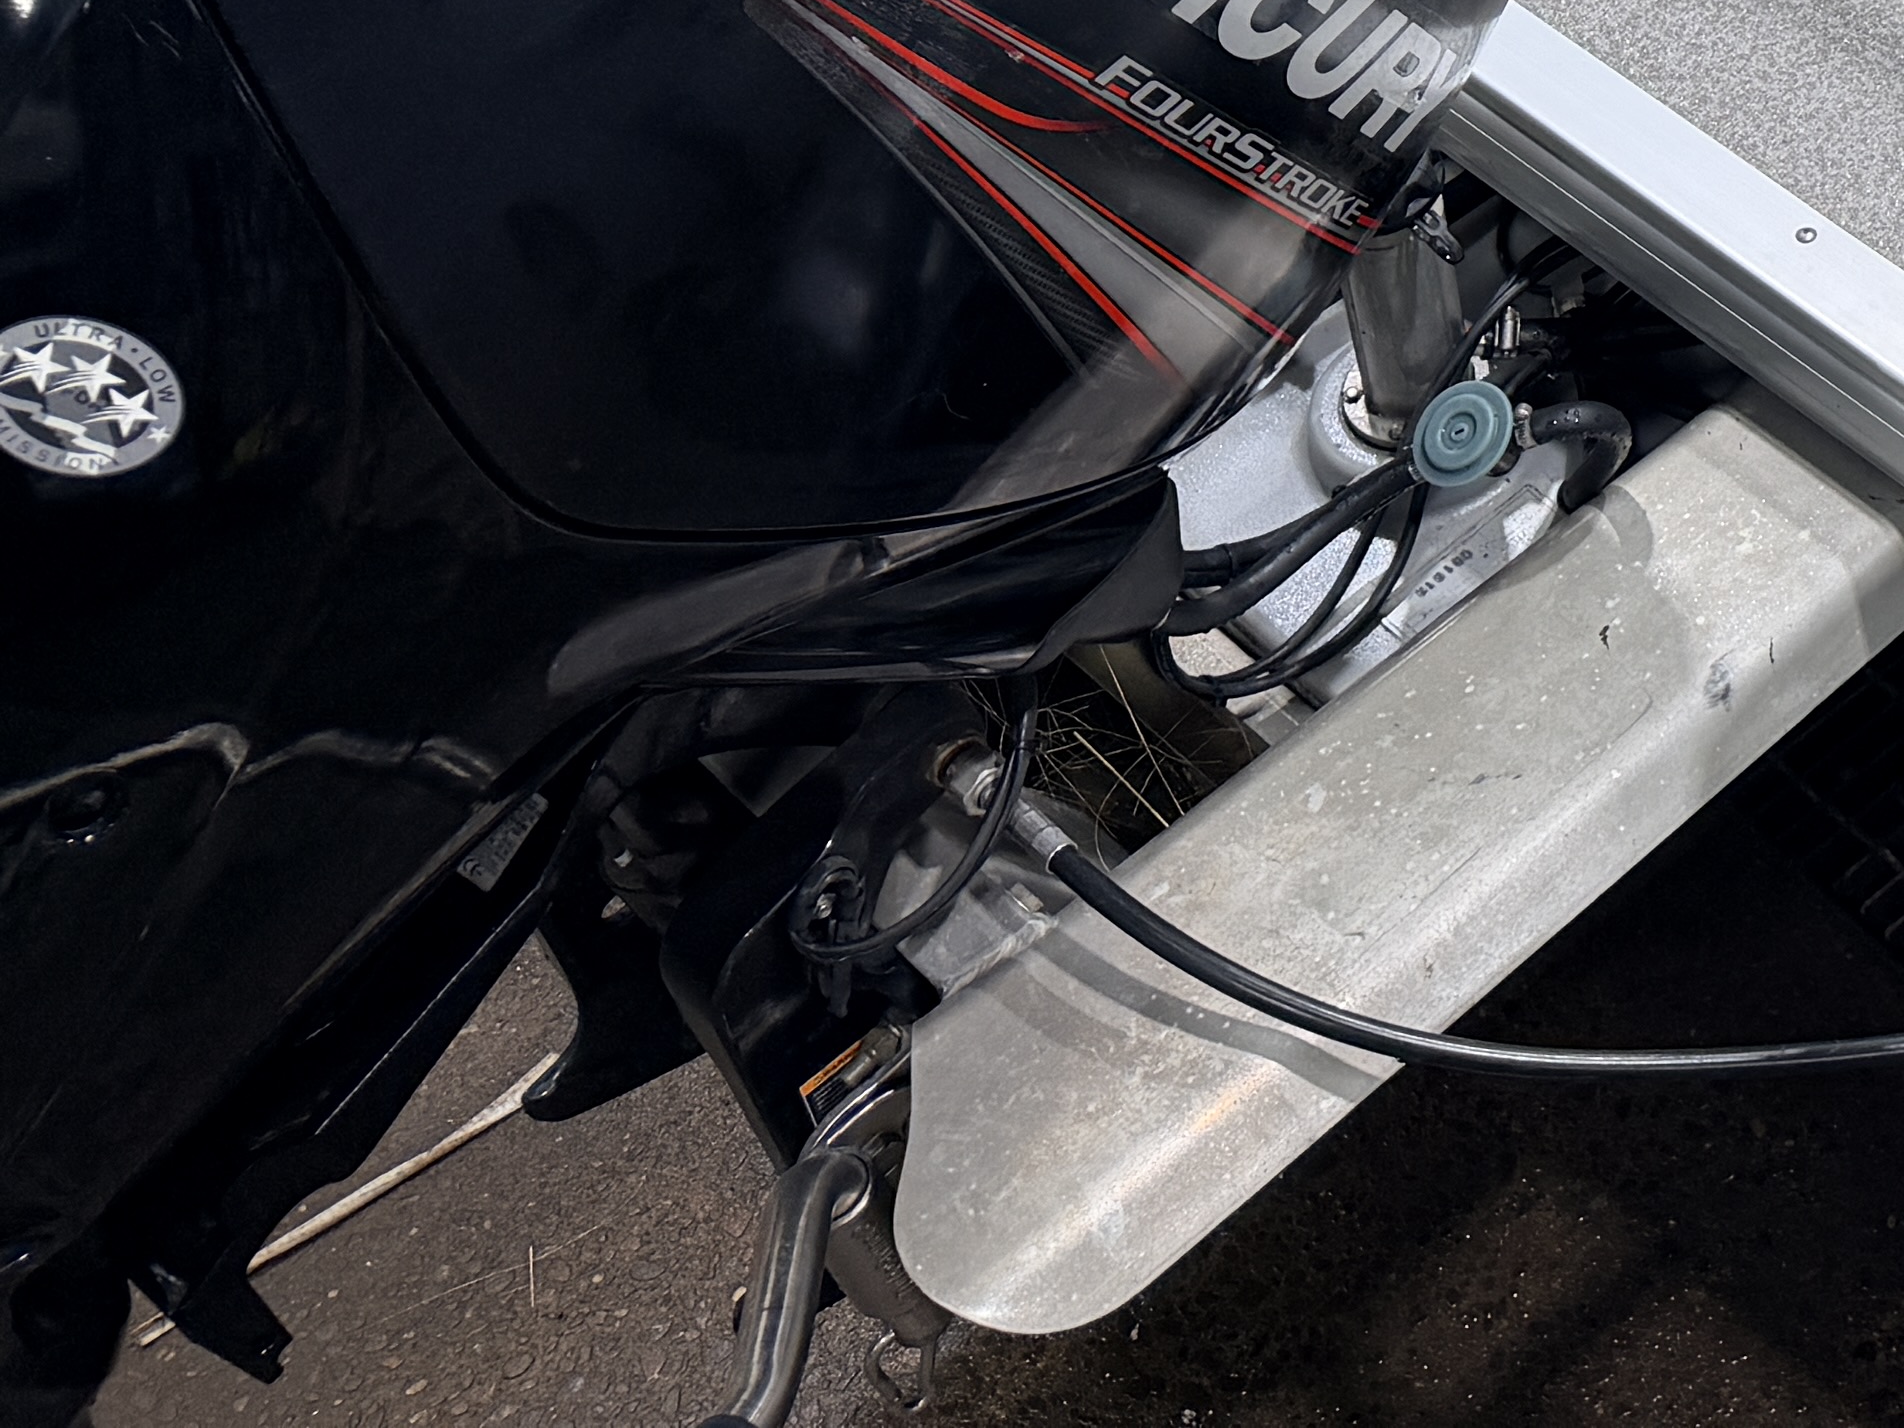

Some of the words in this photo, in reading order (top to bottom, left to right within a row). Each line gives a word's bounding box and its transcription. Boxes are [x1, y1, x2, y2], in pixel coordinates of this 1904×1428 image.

[1094, 55, 1370, 227] FOURSTROKE
[34, 322, 124, 350] ULTRA
[139, 356, 176, 404] LOW
